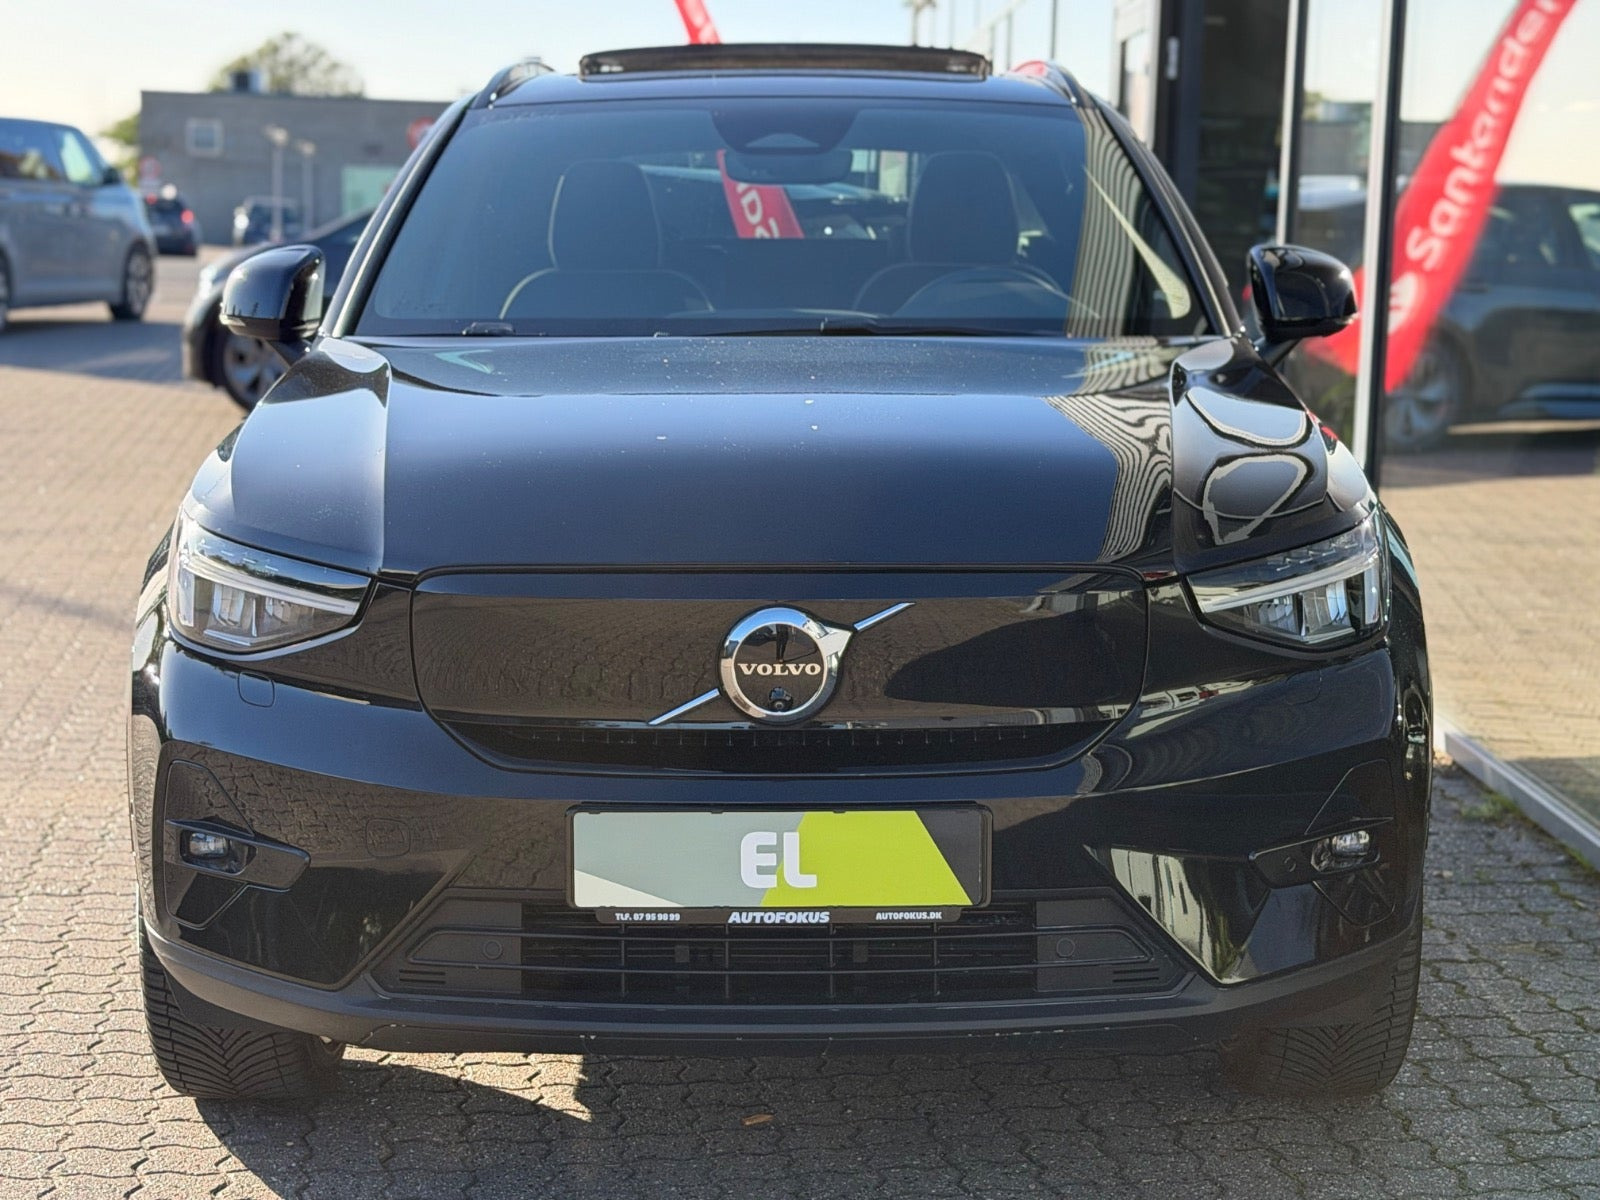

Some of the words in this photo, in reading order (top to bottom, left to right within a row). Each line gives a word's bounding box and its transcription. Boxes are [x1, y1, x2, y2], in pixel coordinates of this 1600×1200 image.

[738, 663, 821, 676] VOLVO
[740, 831, 818, 889] EL
[727, 911, 831, 924] AUTOFOKUS
[875, 911, 943, 921] AUTOFOKUS.DK
